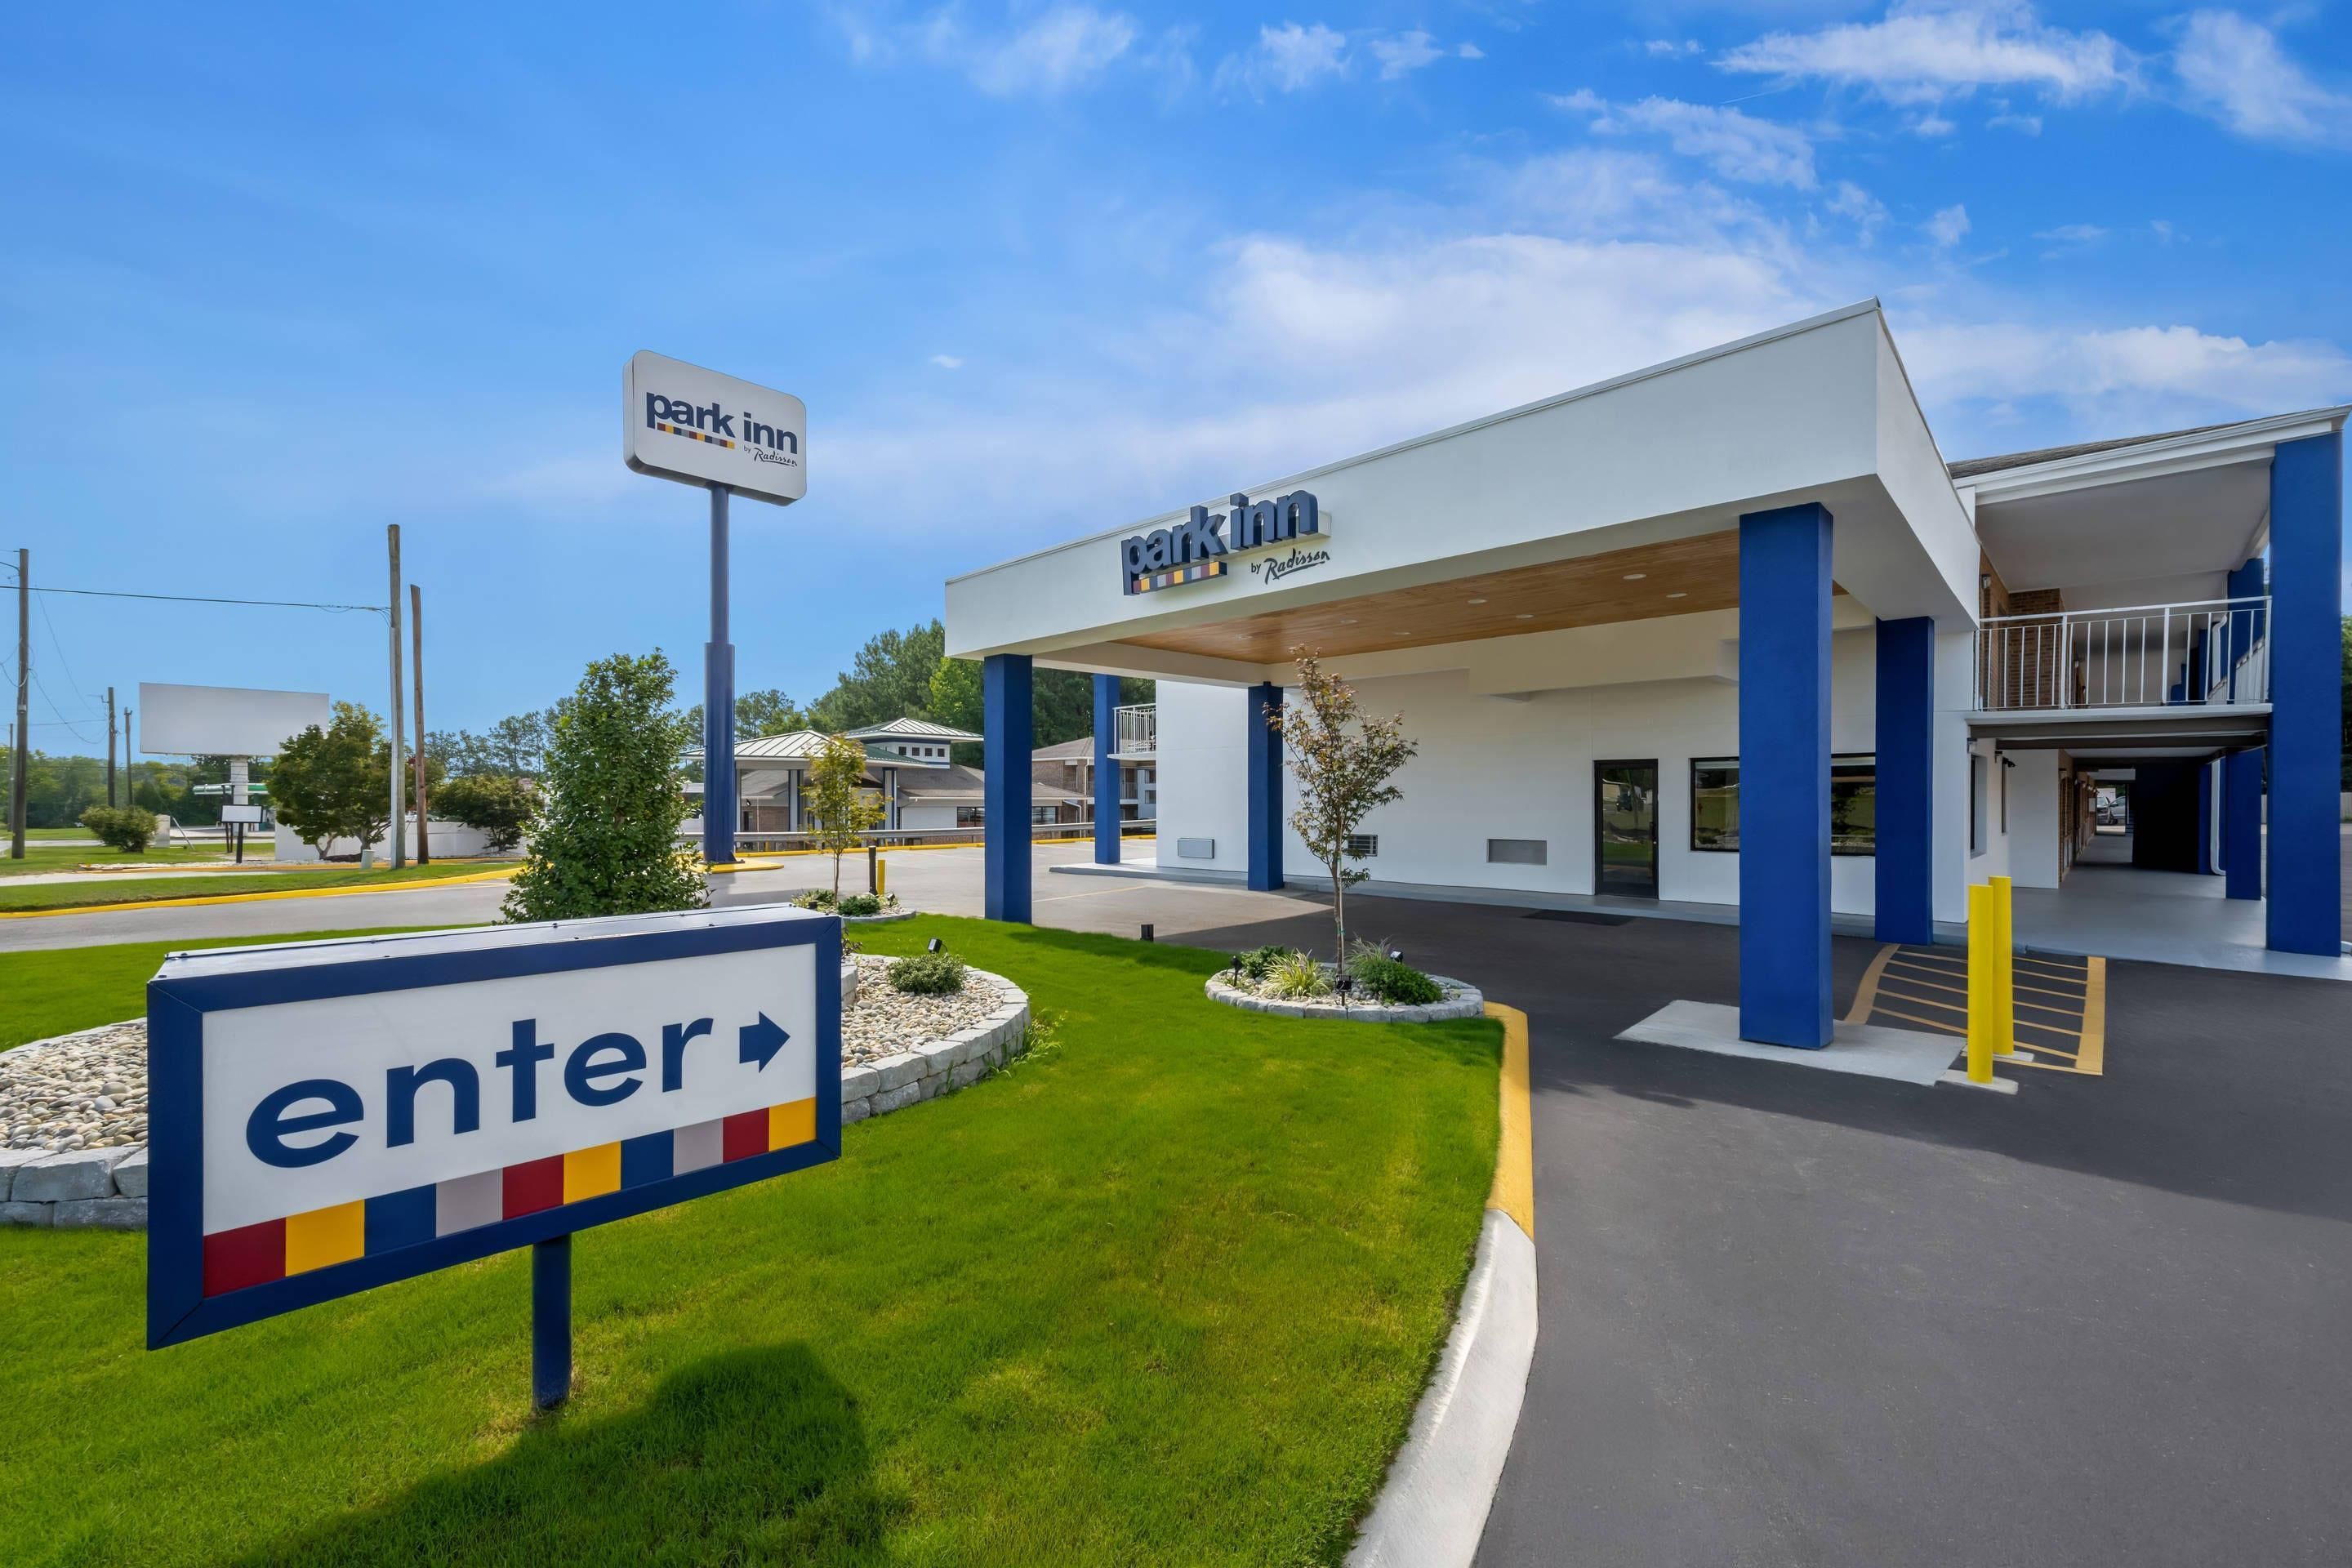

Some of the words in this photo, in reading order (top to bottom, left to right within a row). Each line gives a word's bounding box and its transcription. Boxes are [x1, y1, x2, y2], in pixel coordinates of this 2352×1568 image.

[646, 392, 735, 439] park
[743, 412, 798, 455] inn
[743, 445, 751, 453] by
[753, 447, 798, 468] Radisson
[1121, 505, 1228, 595] park
[1230, 490, 1319, 550] inn
[1250, 562, 1262, 574] by
[1263, 548, 1330, 586] Radisson
[245, 1018, 714, 1169] enter
